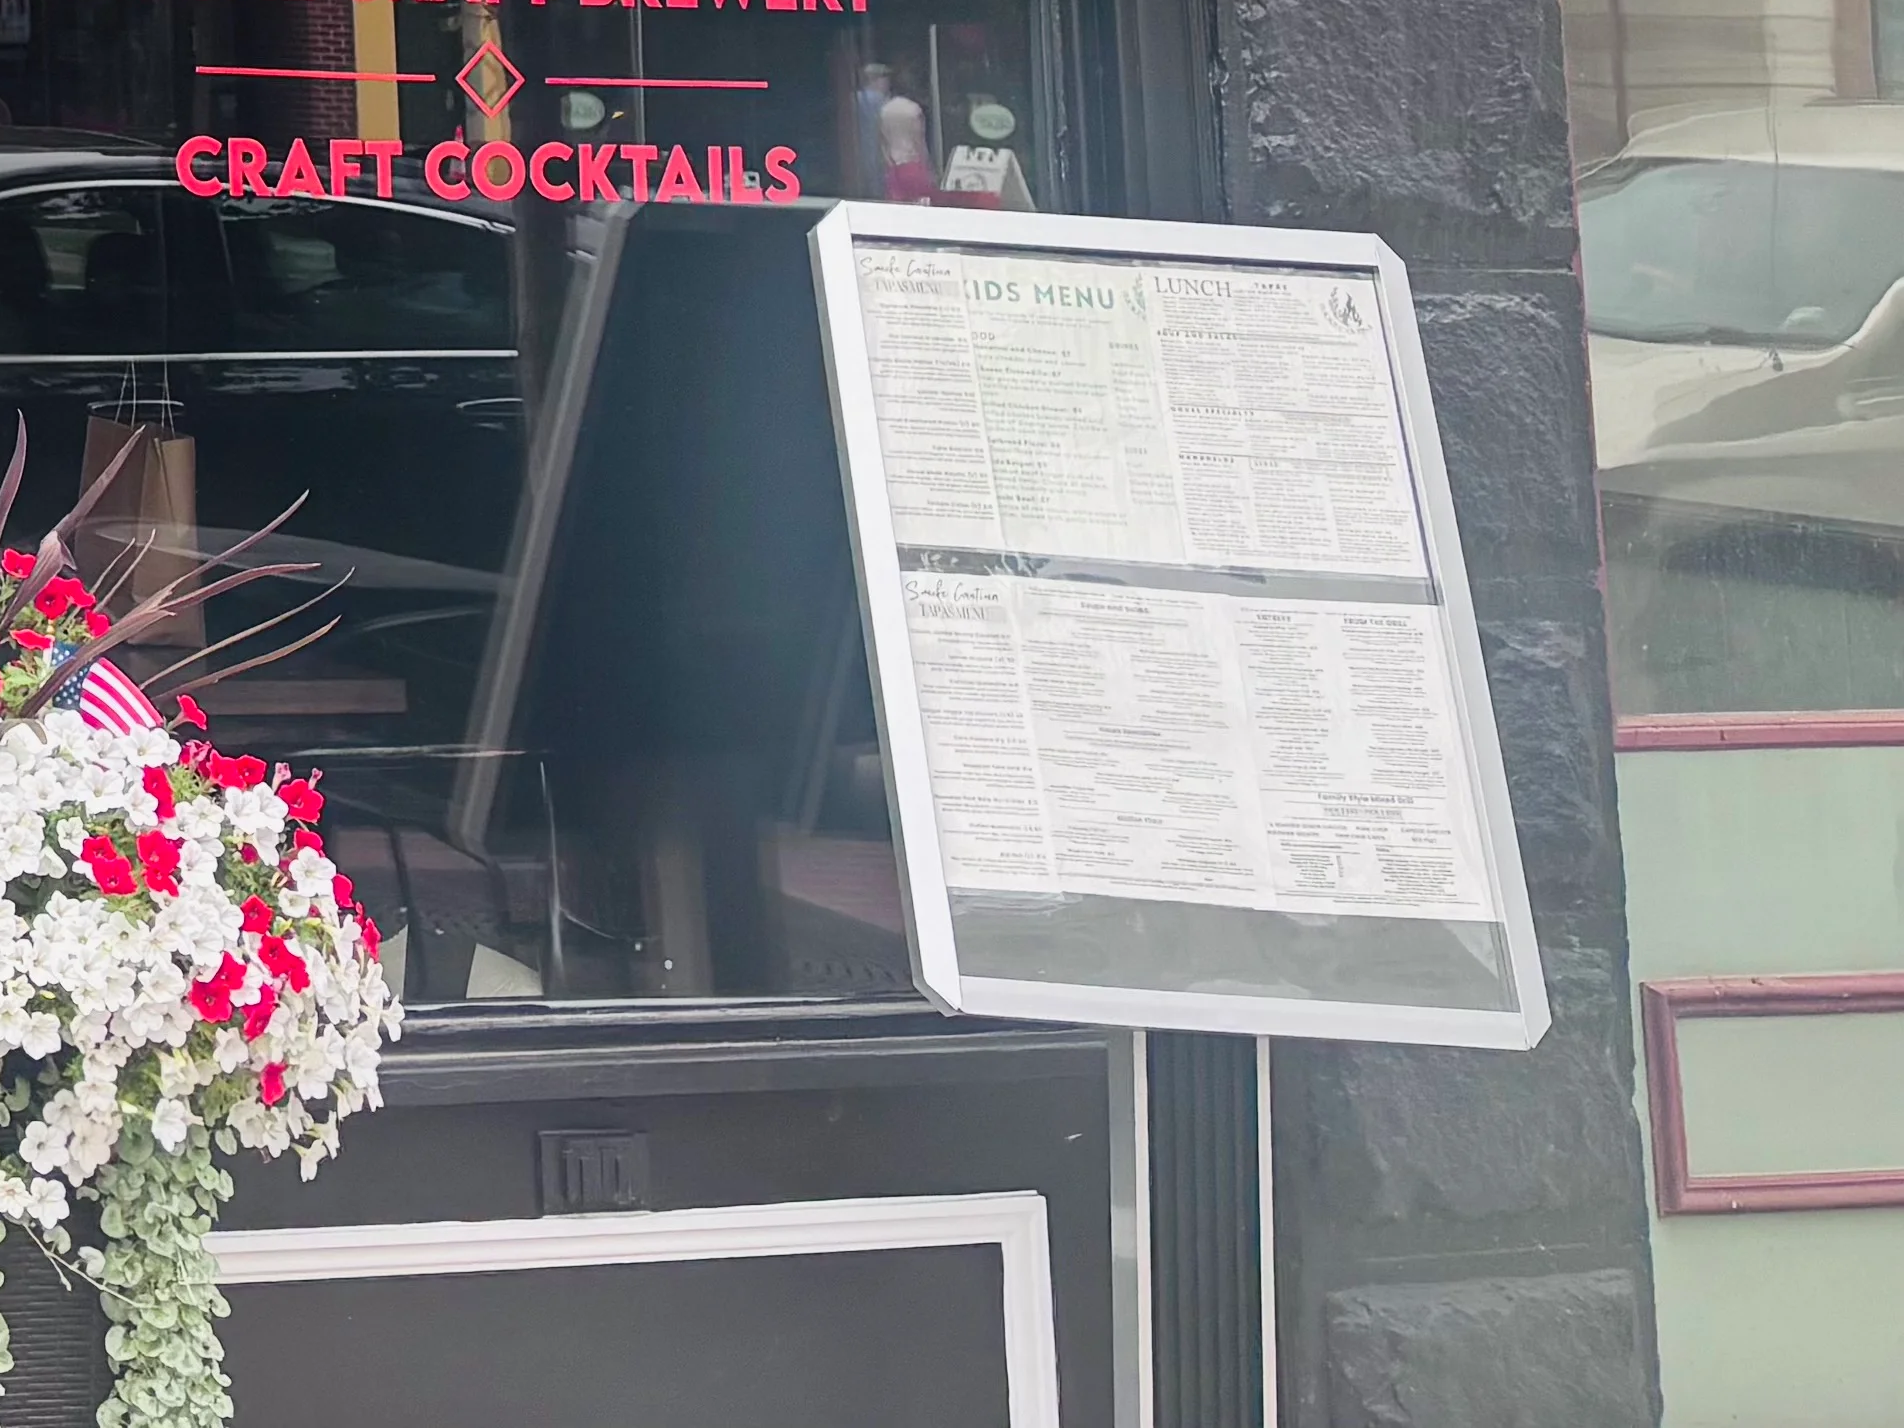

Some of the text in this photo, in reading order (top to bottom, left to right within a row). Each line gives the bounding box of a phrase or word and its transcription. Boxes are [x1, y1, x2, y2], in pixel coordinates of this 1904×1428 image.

[175, 135, 801, 204] CRAFT COCKTAILS
[1033, 282, 1115, 310] MENU
[1154, 276, 1233, 298] LUNCH
